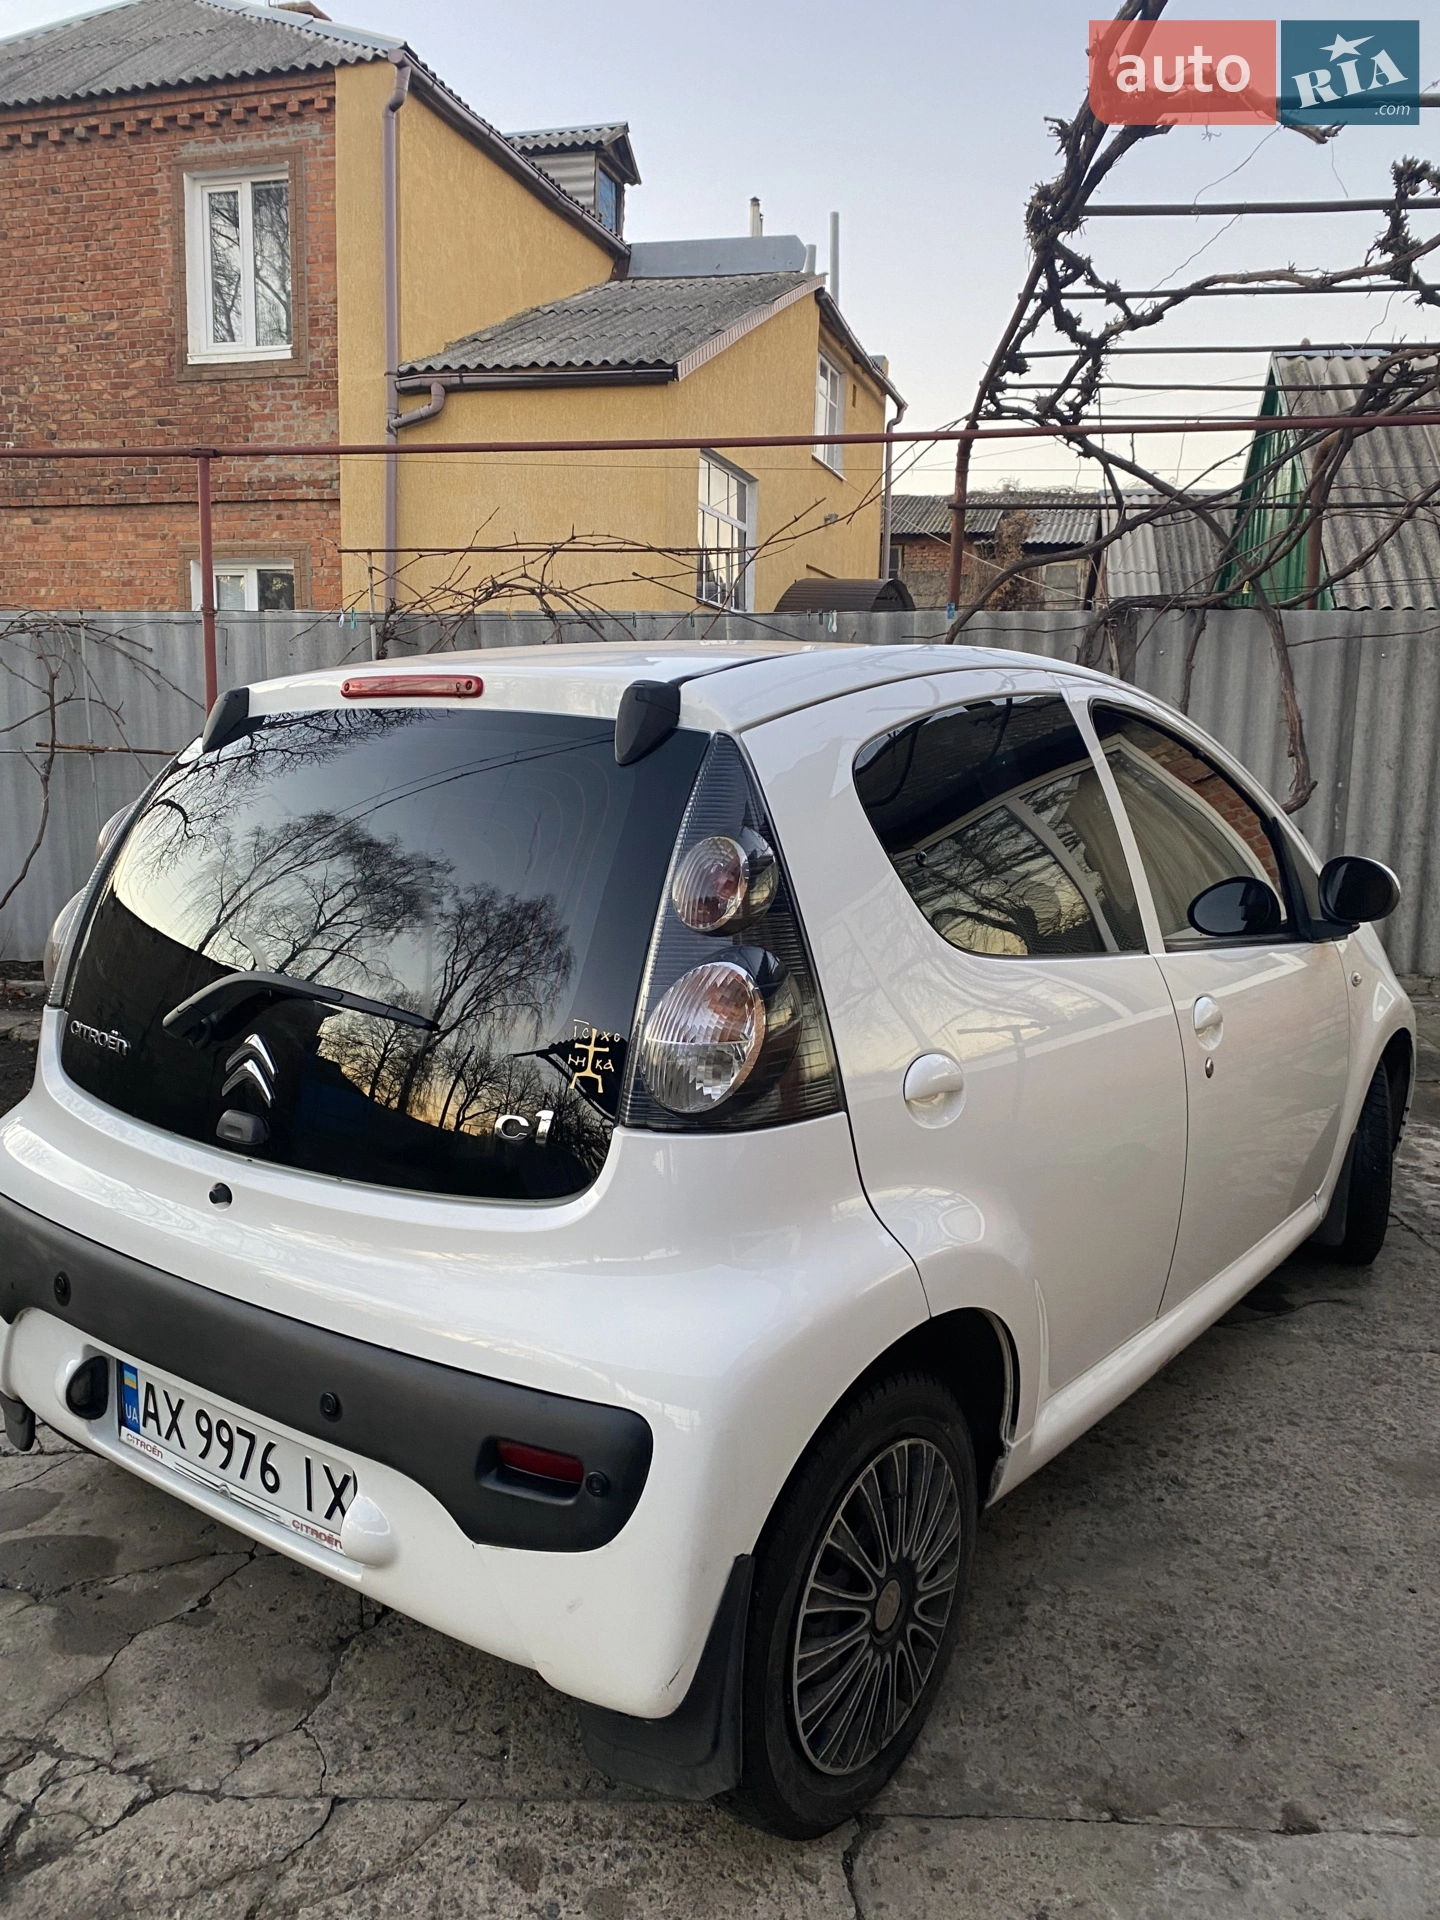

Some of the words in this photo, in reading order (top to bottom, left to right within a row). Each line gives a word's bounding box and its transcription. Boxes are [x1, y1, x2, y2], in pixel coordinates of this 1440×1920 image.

[125, 1403, 139, 1423] UA
[142, 1381, 186, 1450] AX
[195, 1408, 281, 1494] 9976
[304, 1455, 352, 1521] IX
